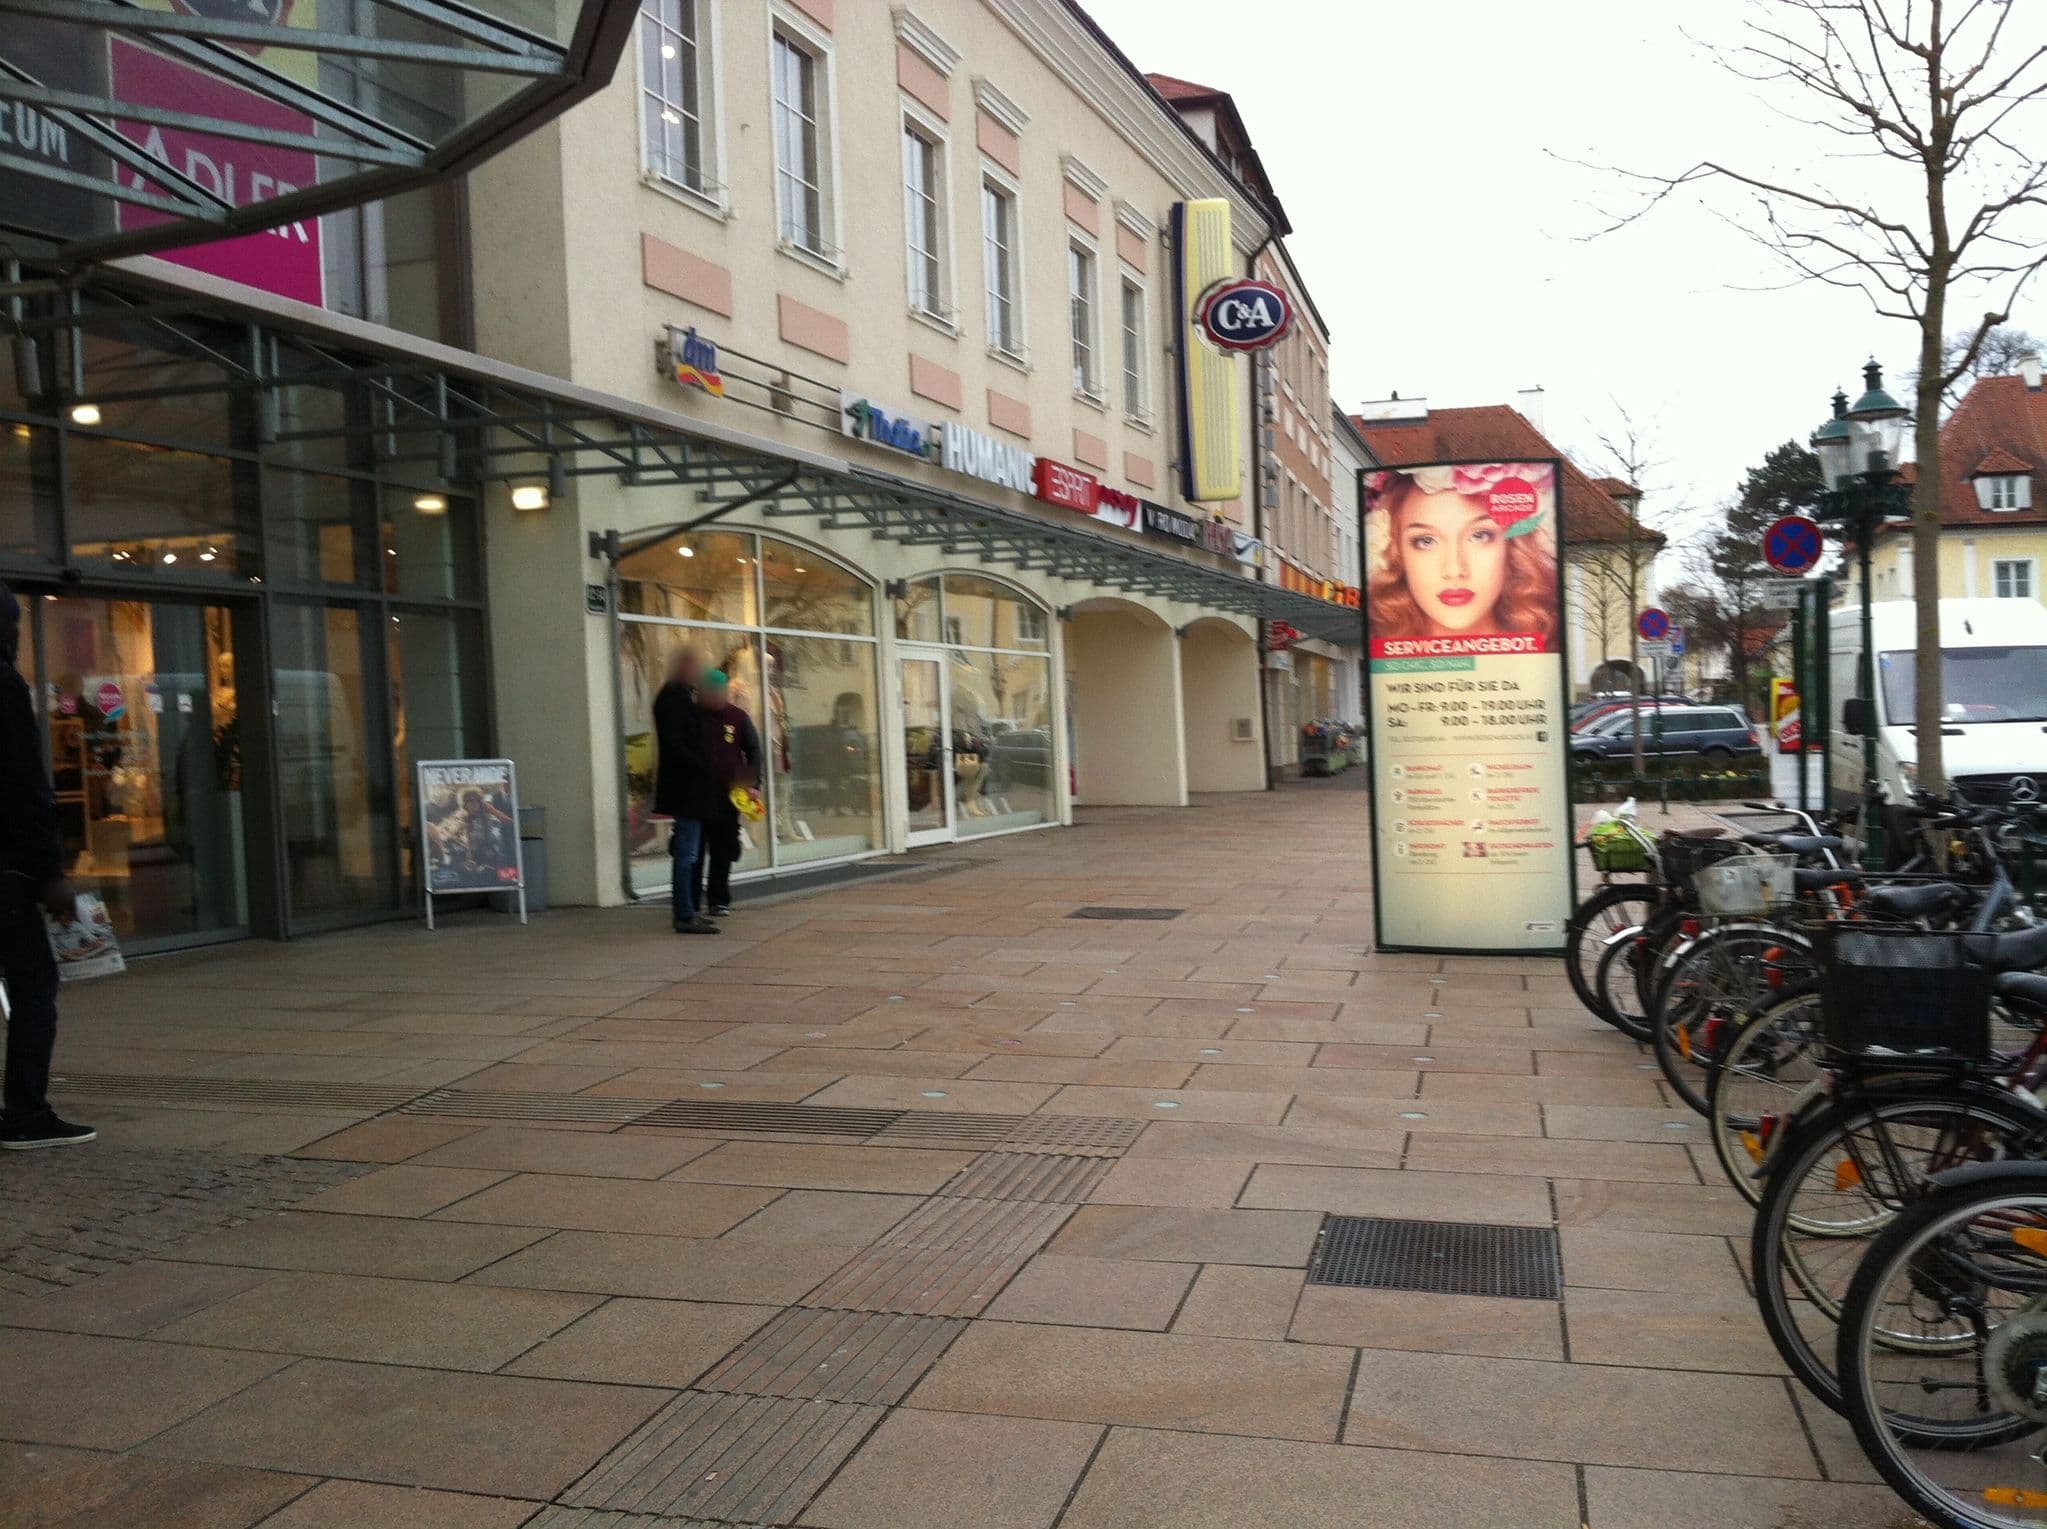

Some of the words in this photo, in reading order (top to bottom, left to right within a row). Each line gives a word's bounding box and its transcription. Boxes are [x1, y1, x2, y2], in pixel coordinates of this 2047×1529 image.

[1217, 296, 1277, 331] C&A
[1490, 493, 1535, 504] ROSEN
[1386, 683, 1412, 694] WIR
[1414, 682, 1446, 693] SIND
[1448, 678, 1476, 692] FÜR
[1477, 681, 1498, 692] SIE
[1501, 680, 1521, 691] DA
[1517, 699, 1546, 710] UHR
[1518, 714, 1547, 725] UHR
